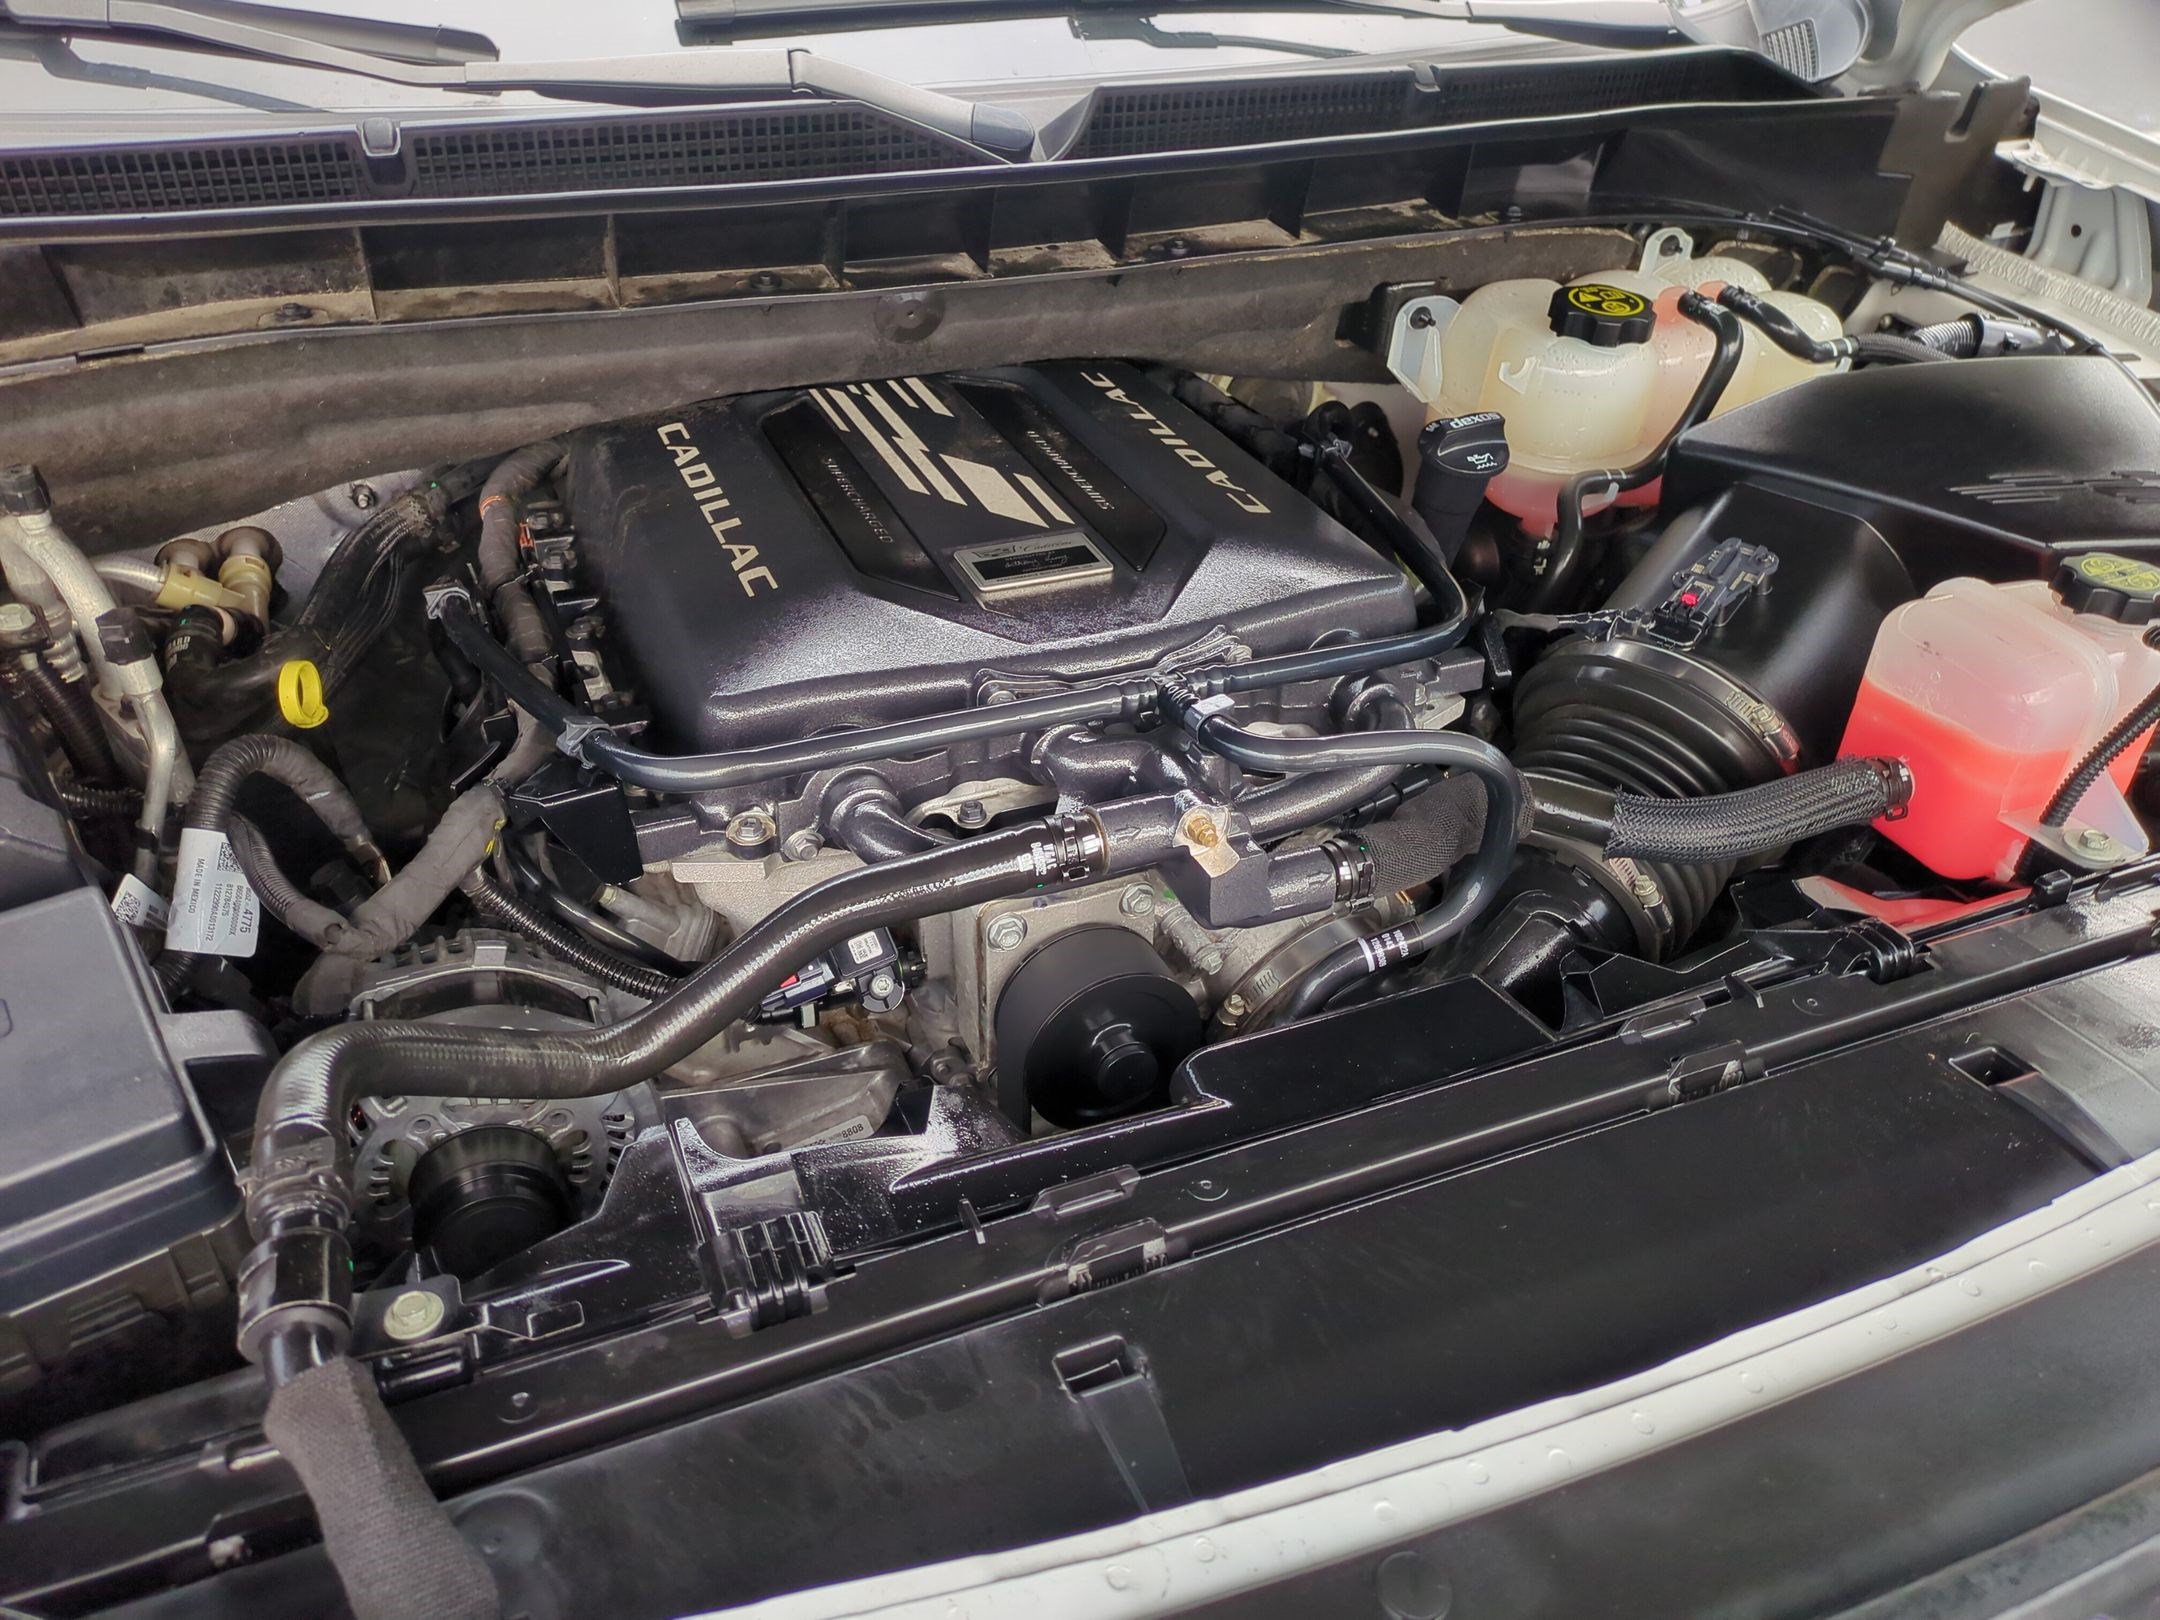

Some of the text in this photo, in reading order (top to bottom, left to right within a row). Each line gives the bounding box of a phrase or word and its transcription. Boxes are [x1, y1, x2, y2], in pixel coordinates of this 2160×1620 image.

[1449, 412, 1501, 429] dexos
[1079, 371, 1272, 514] CADILLAC
[656, 422, 779, 598] CADILLAC
[188, 858, 205, 914] MADE IN MEXICO
[240, 908, 254, 934] 4775
[841, 1123, 864, 1138] 8808
